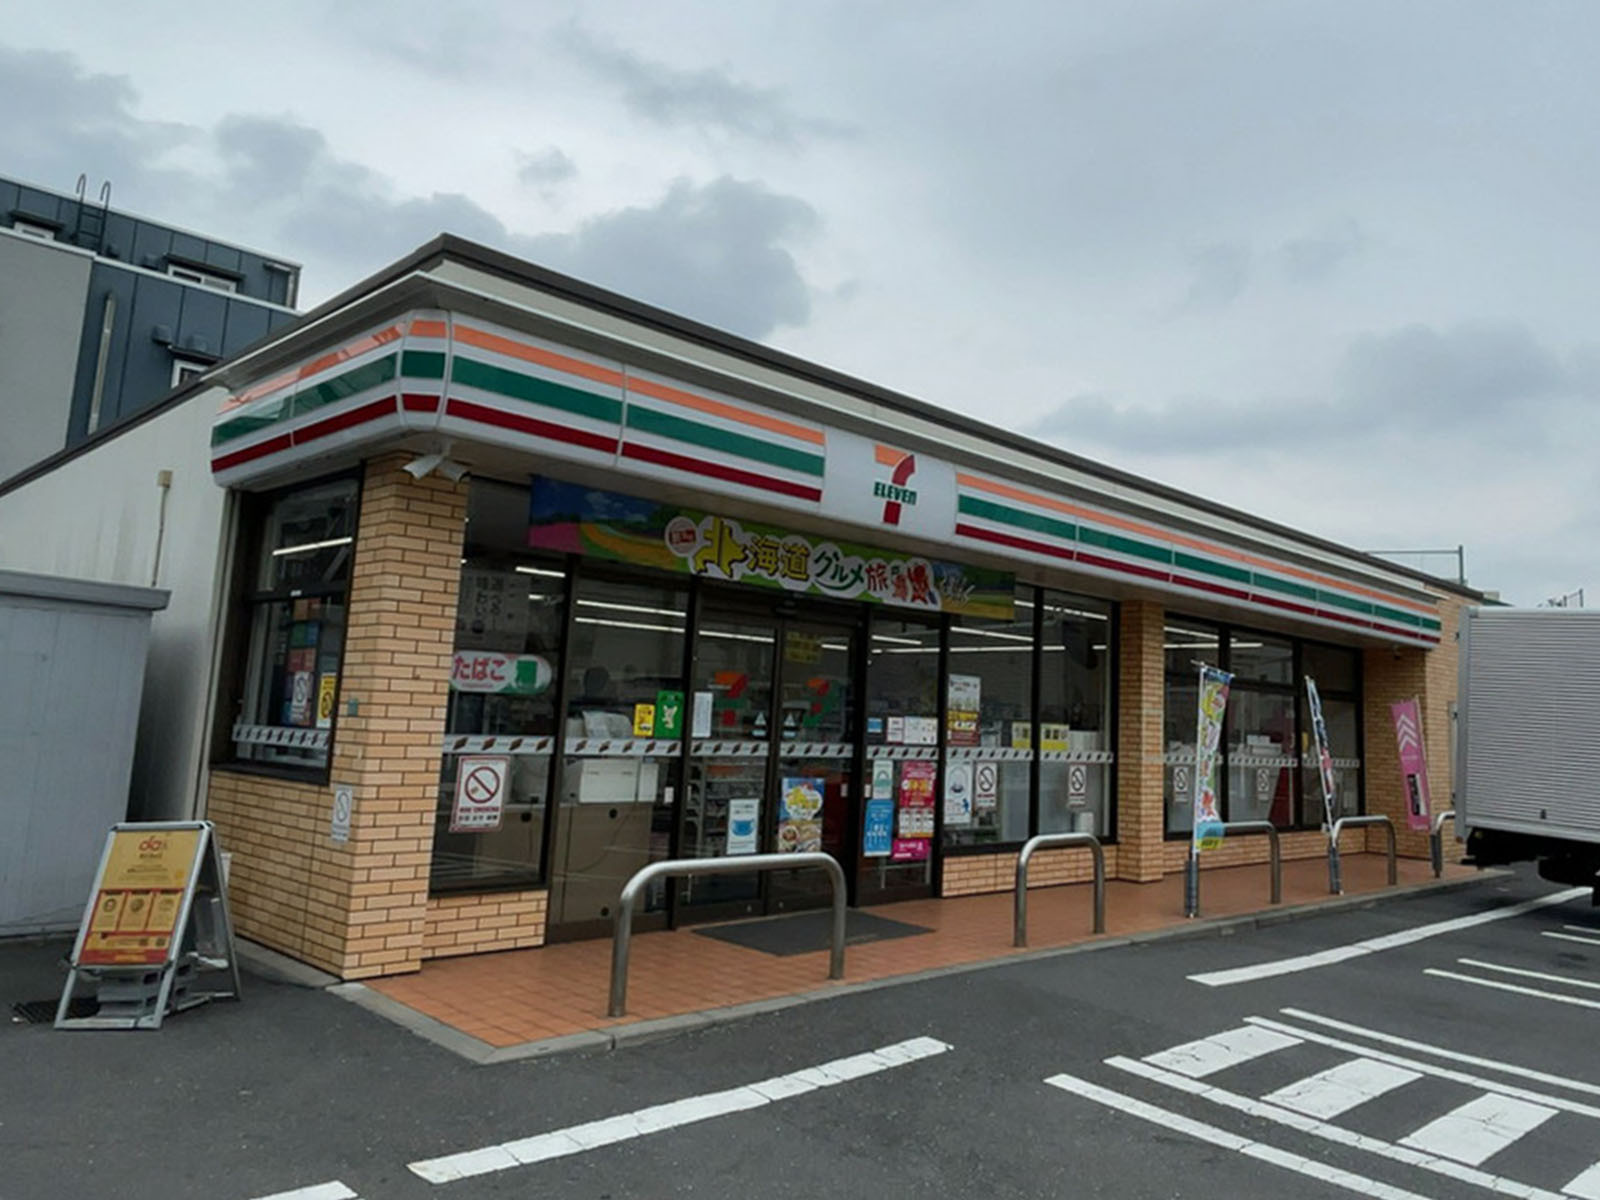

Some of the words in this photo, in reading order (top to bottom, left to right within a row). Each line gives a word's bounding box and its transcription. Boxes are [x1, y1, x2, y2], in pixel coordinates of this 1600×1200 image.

[875, 444, 915, 525] 7
[453, 656, 506, 681] たばこ
